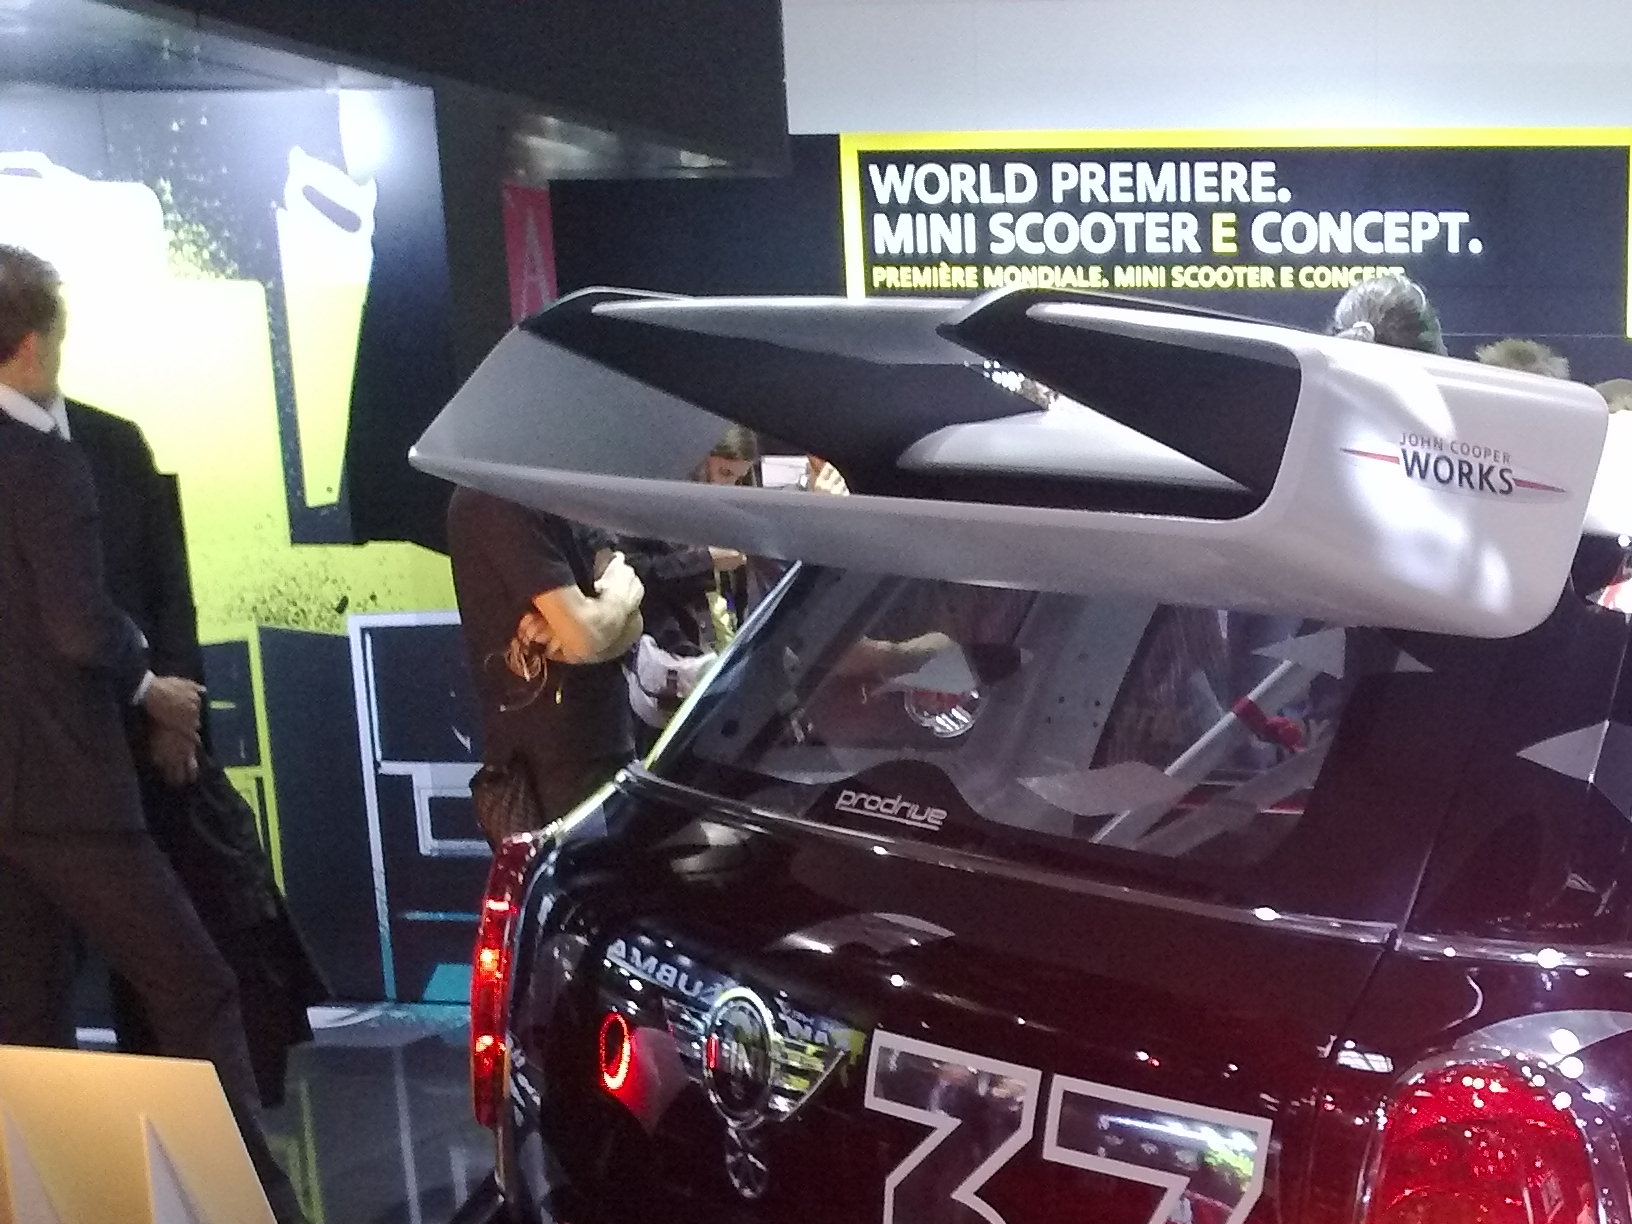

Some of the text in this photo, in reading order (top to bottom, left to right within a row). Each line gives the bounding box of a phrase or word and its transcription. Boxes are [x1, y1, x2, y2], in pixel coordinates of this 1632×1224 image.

[869, 161, 1292, 204] WORLD PREMIERE.
[872, 212, 1484, 255] MINI SCOOTER E CONCEPT.
[872, 261, 979, 288] PREMIÈRE
[983, 264, 1110, 288] MONDIALE.
[1114, 265, 1166, 288] MINI
[1171, 265, 1275, 288] SCOOTER
[1281, 266, 1294, 288] E
[1400, 432, 1512, 463] JOHN COOPER
[1401, 450, 1513, 495] WORKS
[834, 789, 948, 826] prodrive
